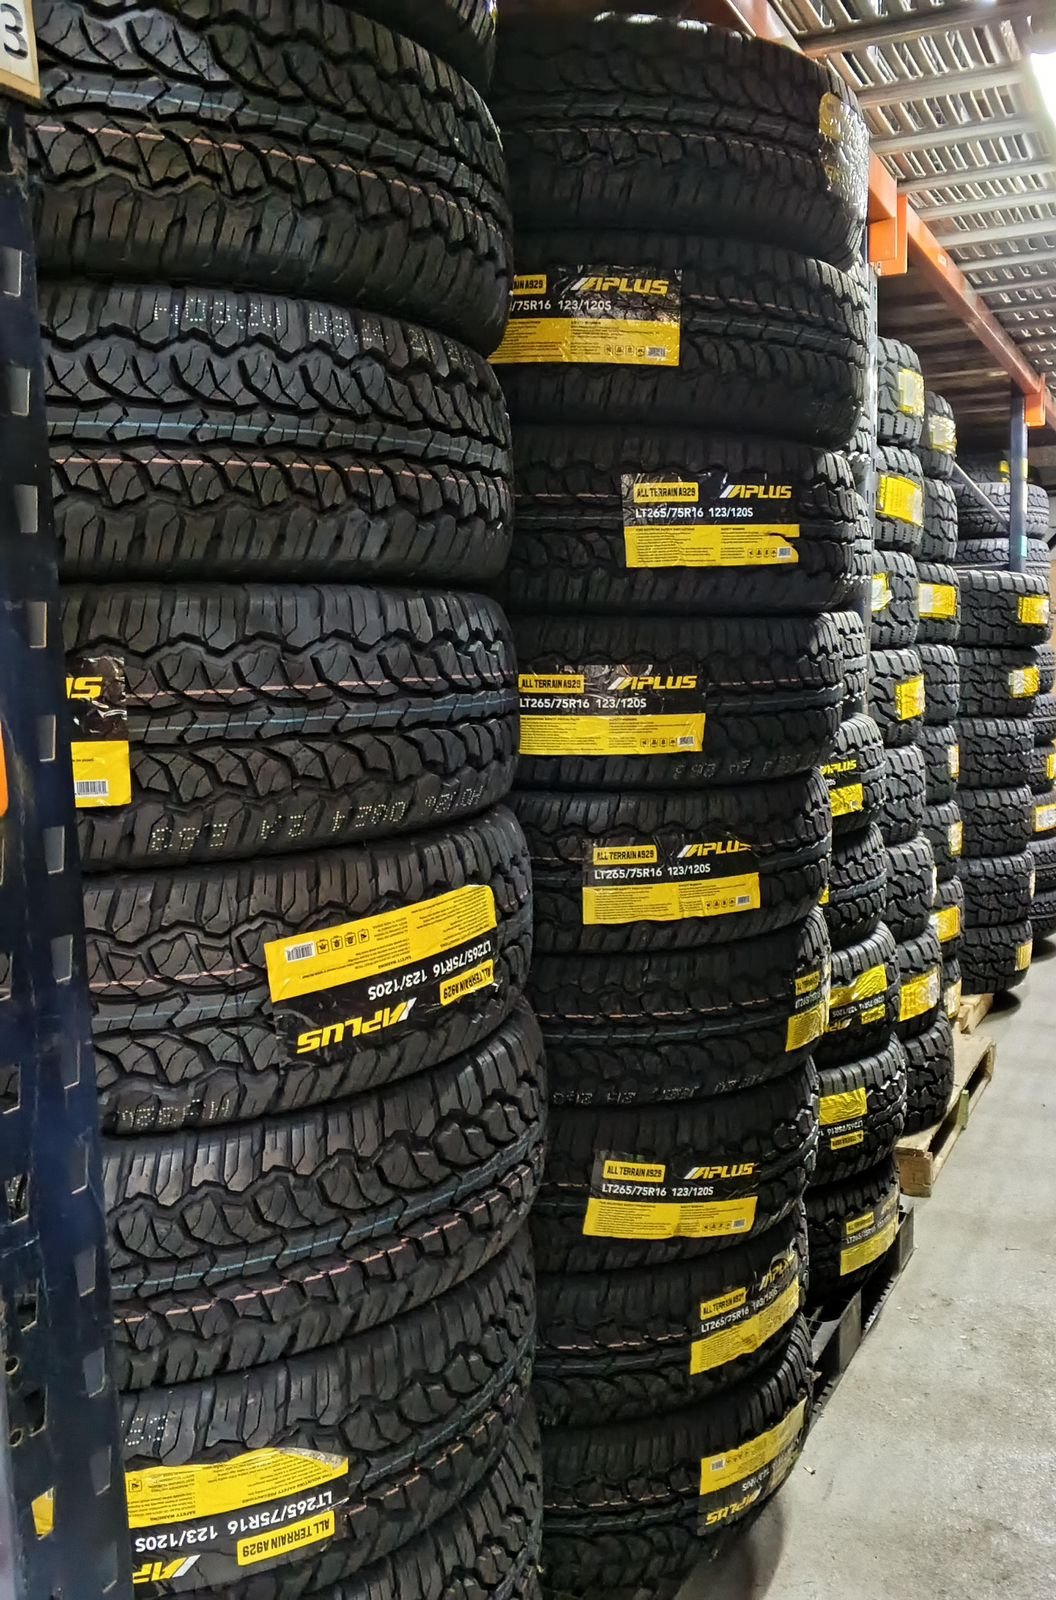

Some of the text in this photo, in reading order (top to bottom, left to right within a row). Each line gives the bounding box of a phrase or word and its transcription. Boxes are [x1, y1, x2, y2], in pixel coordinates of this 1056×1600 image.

[0, 3, 28, 60] 3
[570, 276, 670, 295] APLUS
[557, 299, 612, 312] 123/120S
[636, 484, 794, 499] ALL TERRAIN A929 APLUS
[635, 506, 754, 519] LT265/75R16 123/120S
[521, 675, 698, 691] ALL TERRAIN A929 APLUS
[519, 698, 647, 709] LT265/75R16 123/120S
[597, 851, 609, 861] ALL
[609, 850, 638, 861] TERRAIN
[638, 849, 654, 859] A929
[594, 863, 711, 880] LT265/75R16 123/120S
[368, 940, 491, 1001] LT265/75R16 123/120S
[297, 997, 417, 1054] APLUS
[607, 1162, 755, 1180] ALL TERRAIN A929 APLUS
[602, 1184, 715, 1197] LT265/75R16 123/120S
[701, 1306, 750, 1333] LT265/75R16
[135, 1491, 333, 1553] LT265/75R16 123/120S
[242, 1518, 330, 1557] ALL TERRAIN A929
